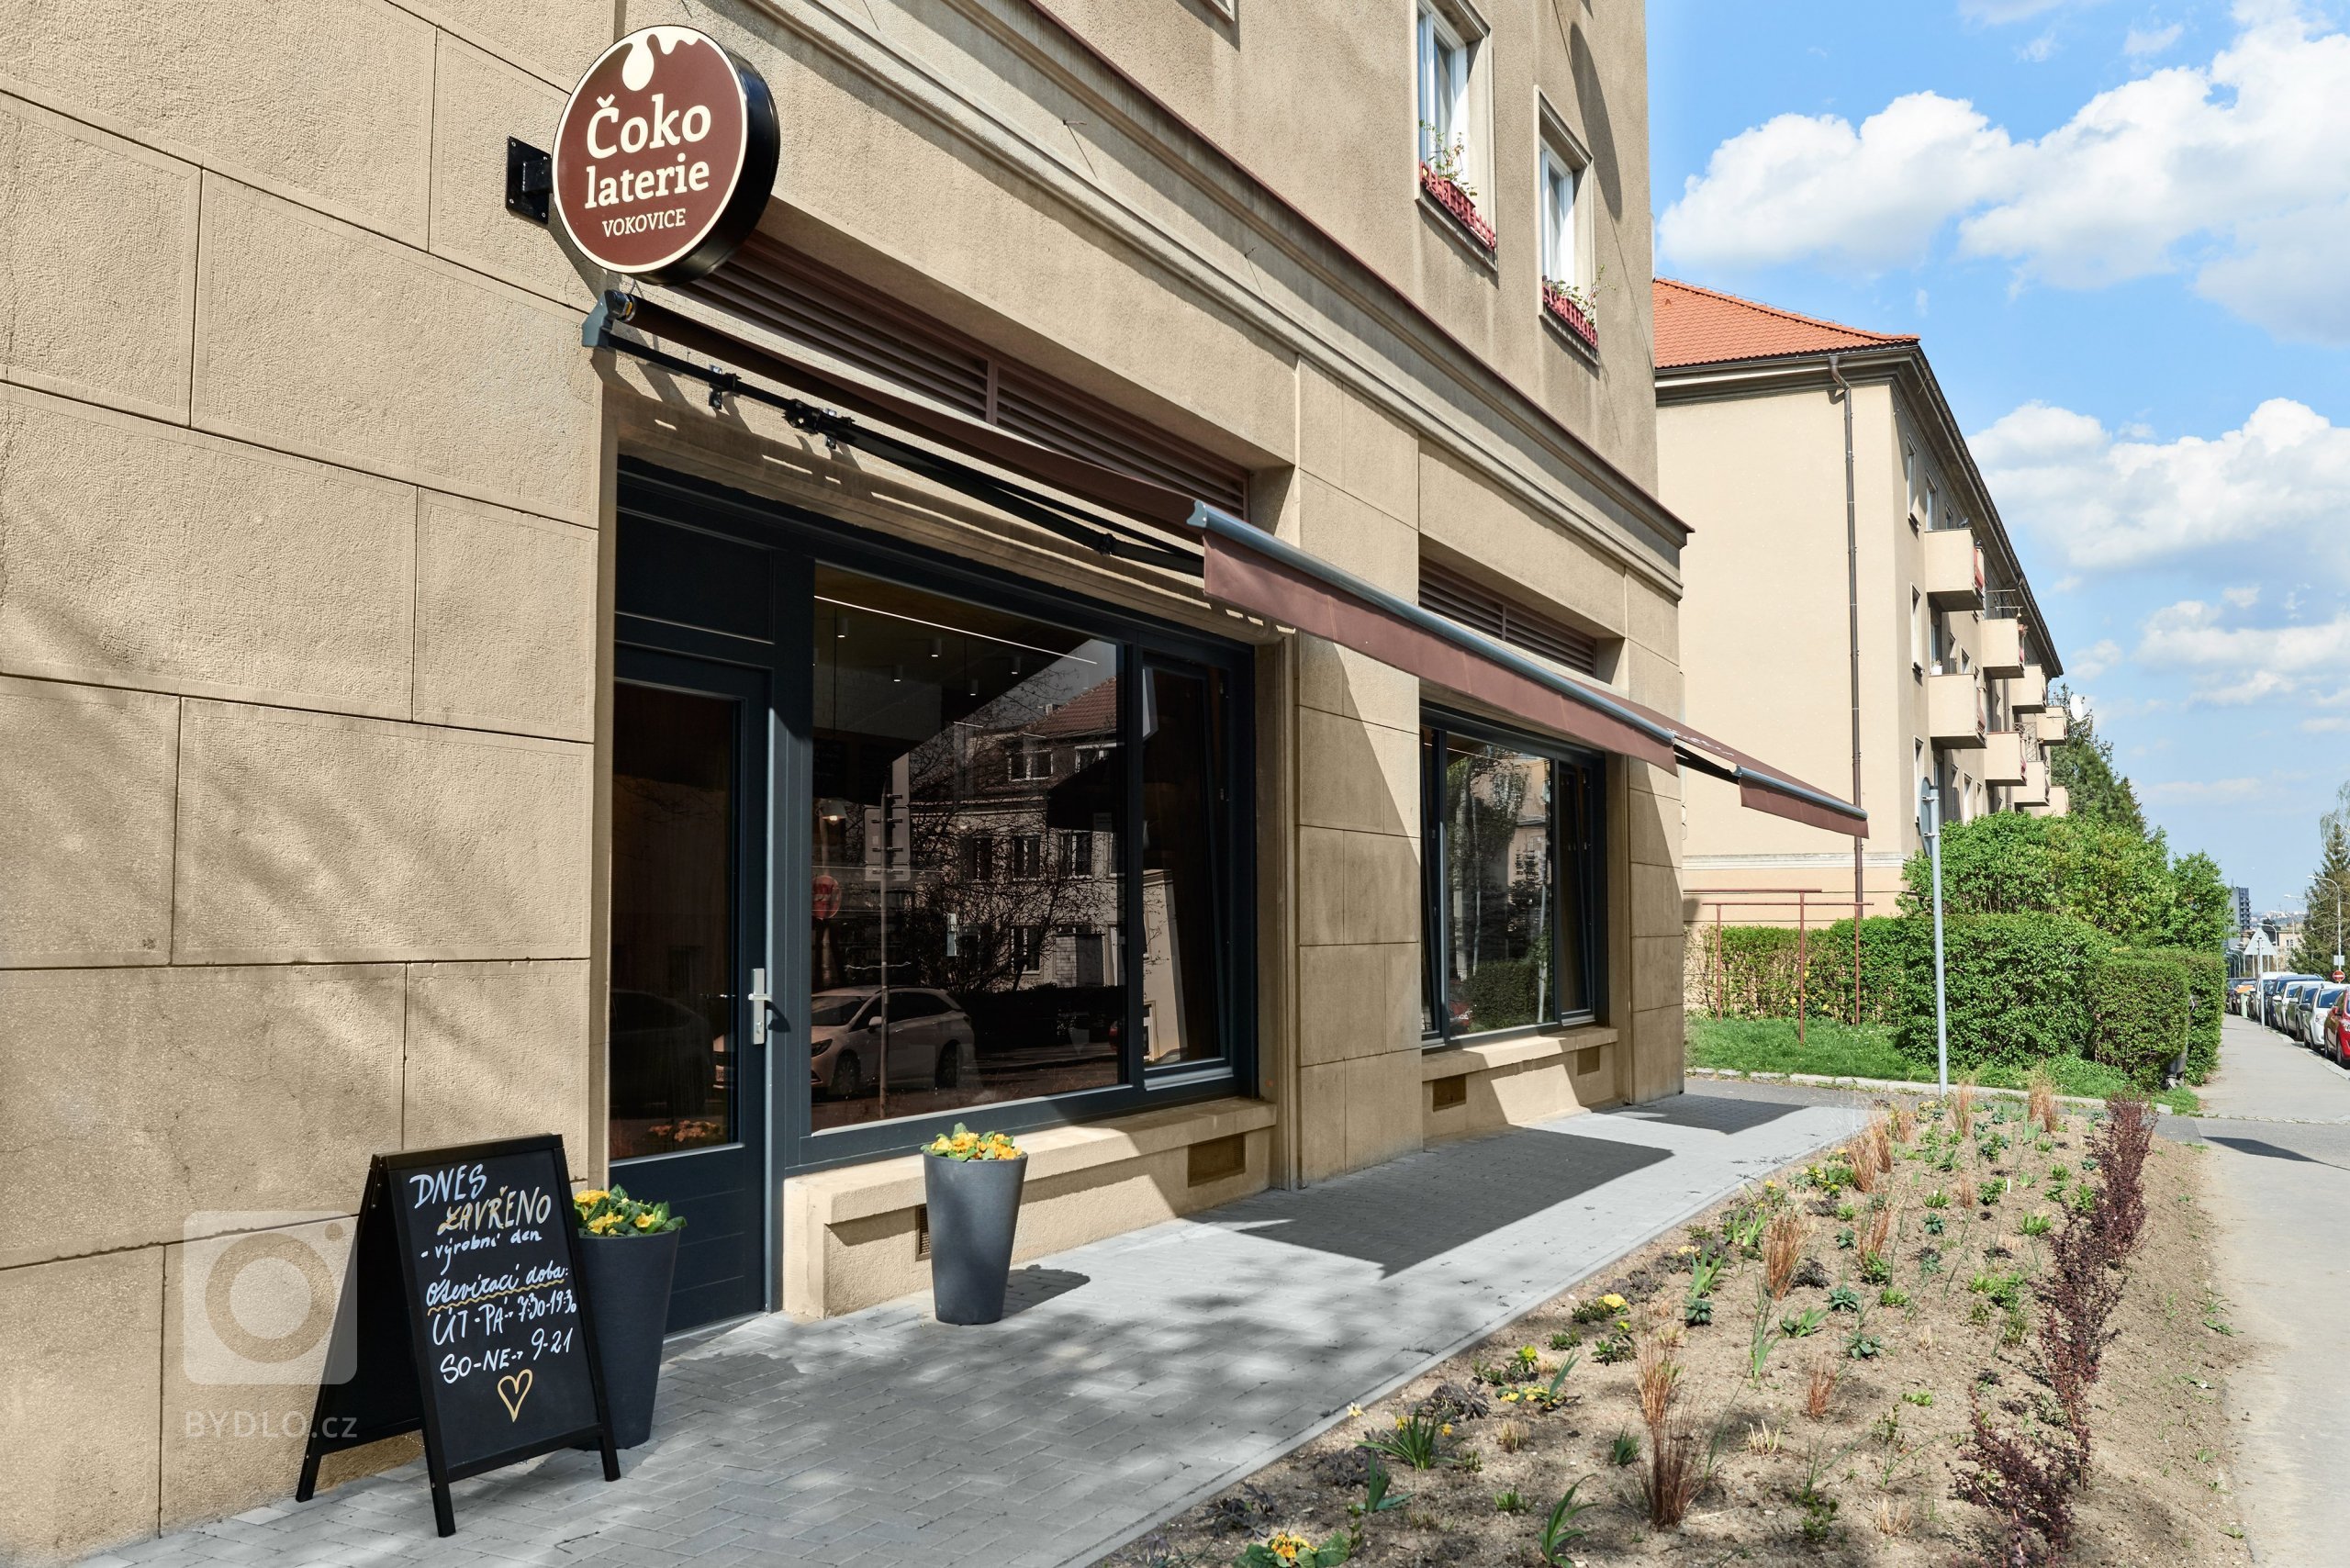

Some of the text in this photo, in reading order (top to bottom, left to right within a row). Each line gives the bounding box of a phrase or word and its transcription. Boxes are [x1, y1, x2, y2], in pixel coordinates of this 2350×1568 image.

[587, 93, 711, 160] Čoko
[584, 152, 710, 209] laterie
[602, 207, 687, 238] VOKOVICE
[409, 1163, 487, 1209] DNES
[437, 1185, 552, 1236] ZAVŘENO
[509, 1228, 543, 1244] den
[525, 1260, 569, 1285] doba:
[531, 1327, 574, 1361] 9-21
